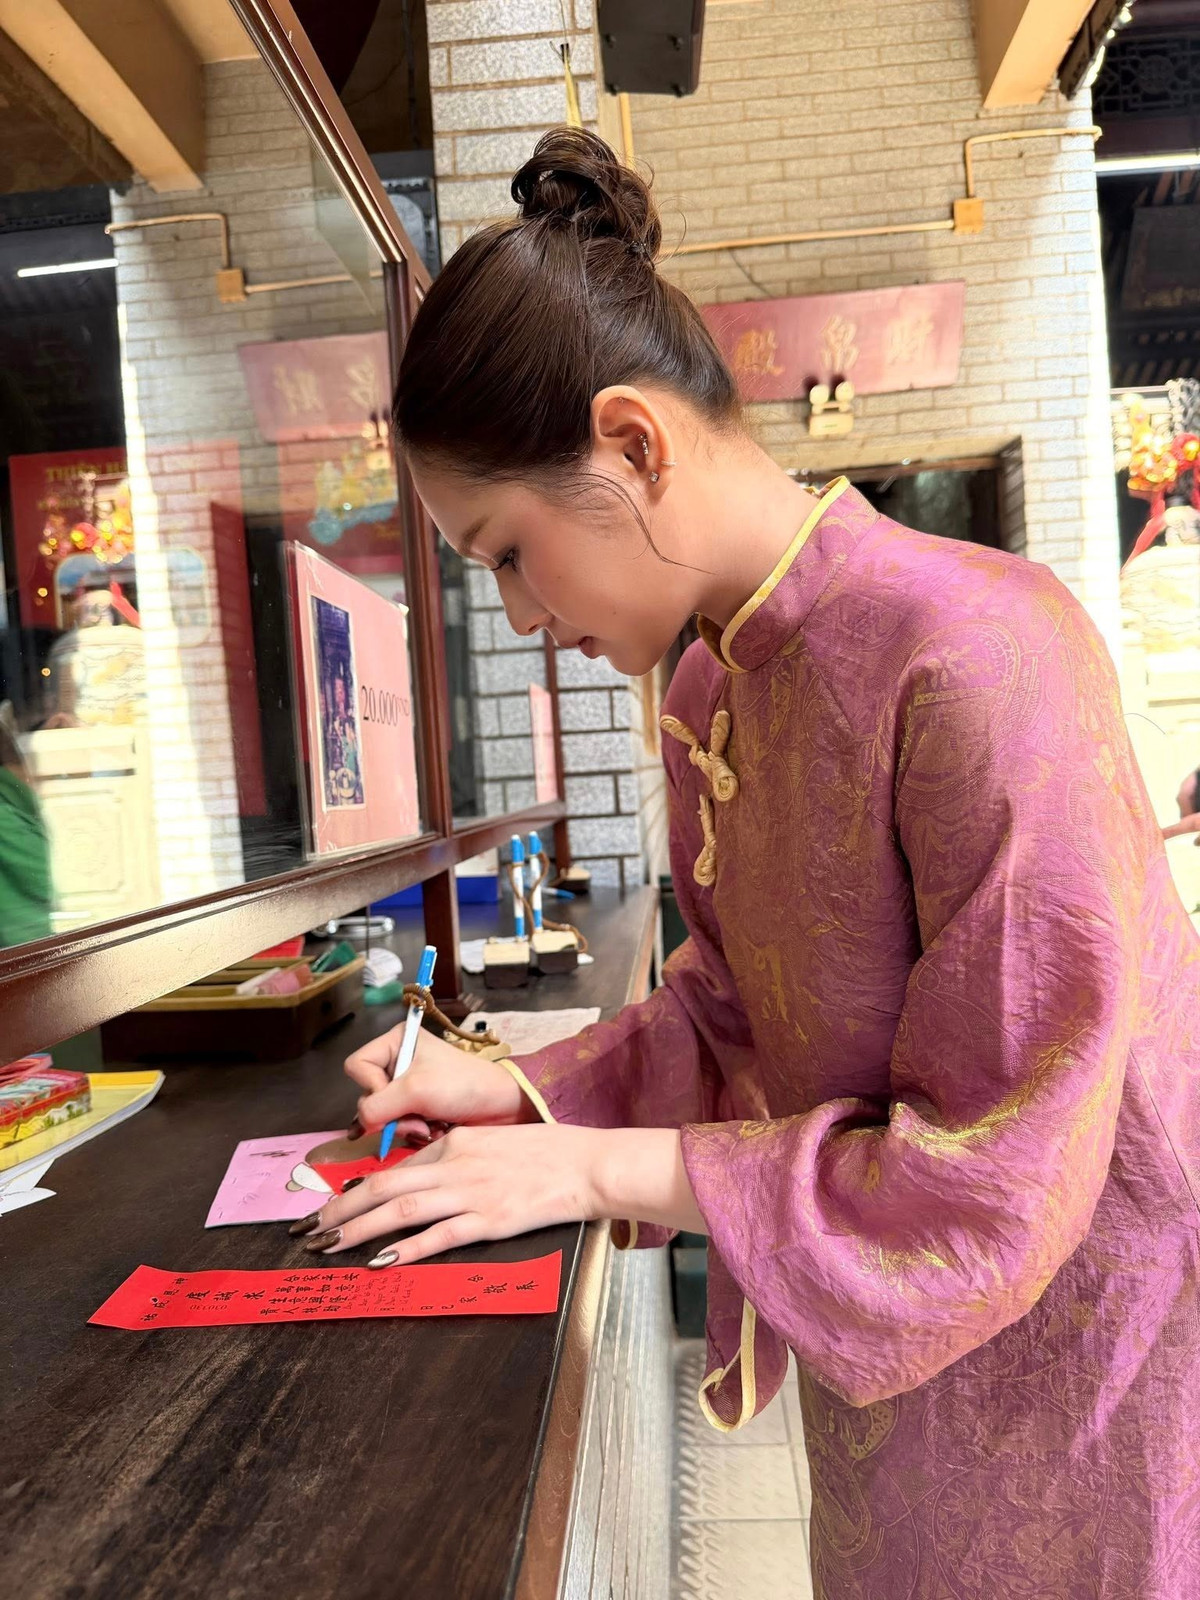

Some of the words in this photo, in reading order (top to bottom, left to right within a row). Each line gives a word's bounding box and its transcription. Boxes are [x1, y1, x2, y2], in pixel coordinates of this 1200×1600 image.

[283, 1272, 360, 1283] 合家平安
[274, 1284, 355, 1294] 萬事如意
[268, 1294, 349, 1304] 生意興隆
[259, 1305, 341, 1315] 貴人扶助
